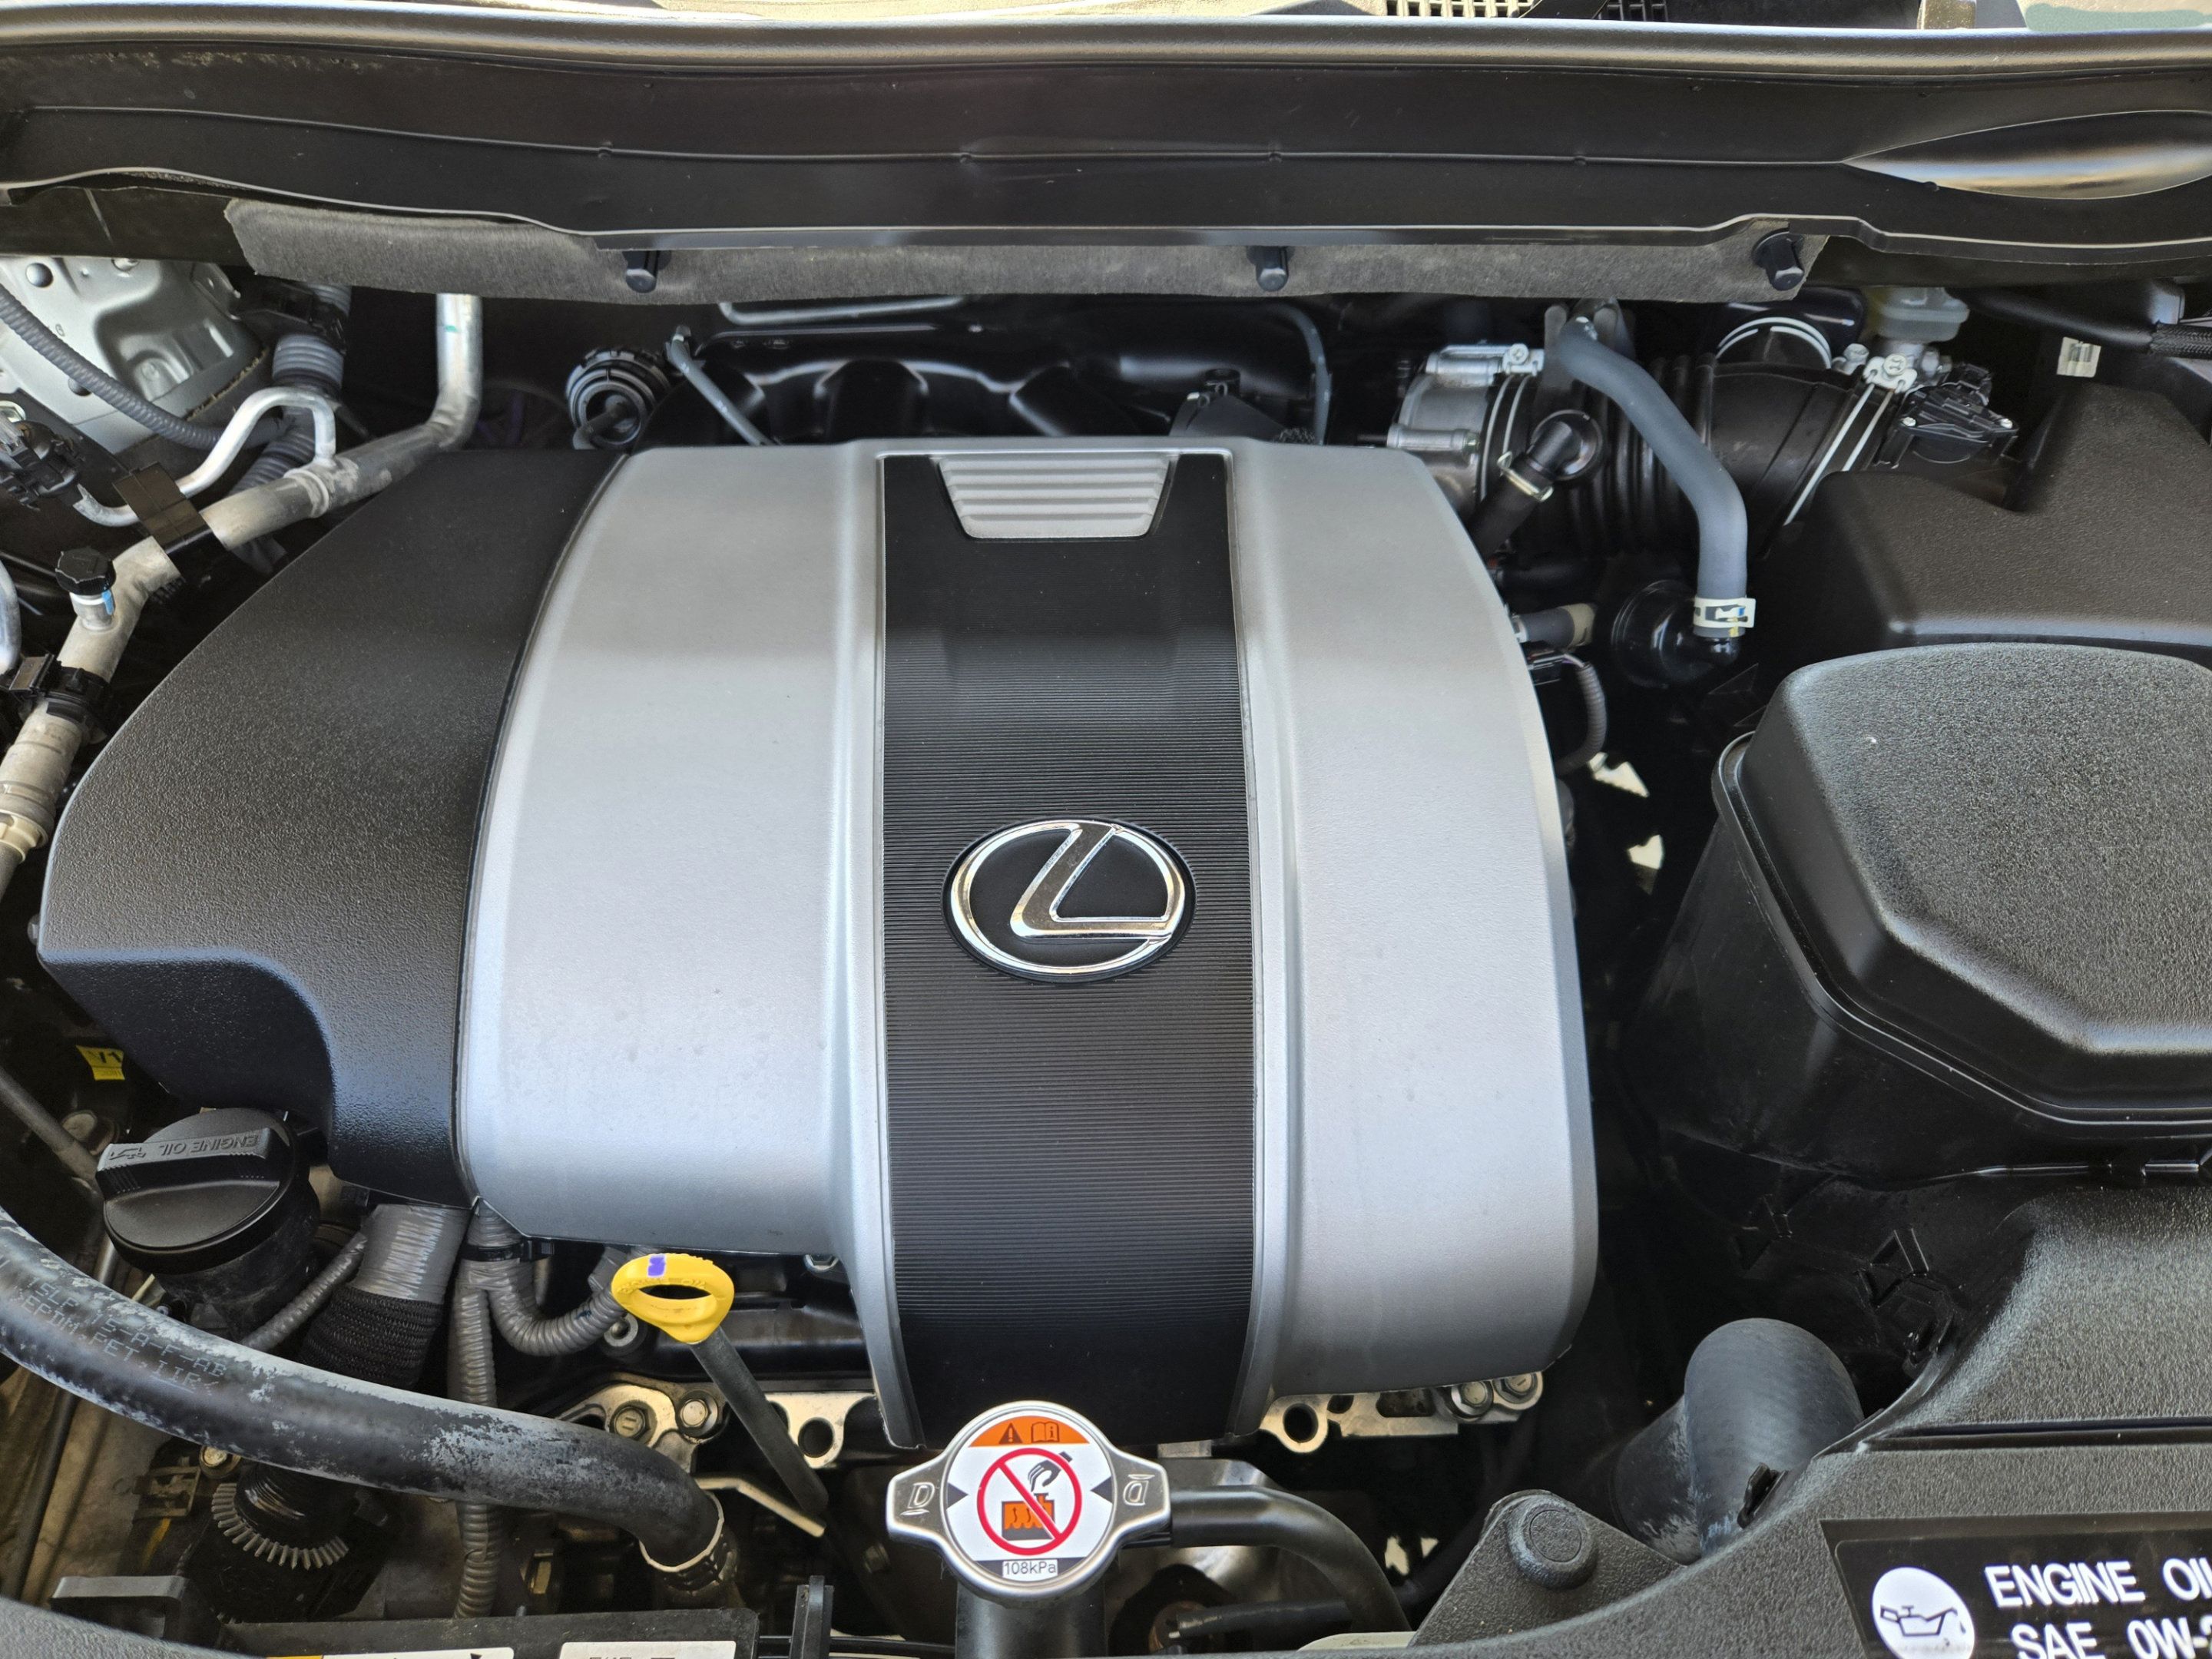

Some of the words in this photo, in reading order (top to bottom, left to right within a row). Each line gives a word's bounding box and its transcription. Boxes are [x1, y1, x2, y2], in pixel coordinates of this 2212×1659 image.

[159, 1142, 187, 1156] OIL
[190, 1134, 259, 1154] ENGINE
[1004, 1561, 1057, 1575] 108kPa
[1985, 1559, 2147, 1608] ENGINE
[2011, 1621, 2107, 1659] SAE
